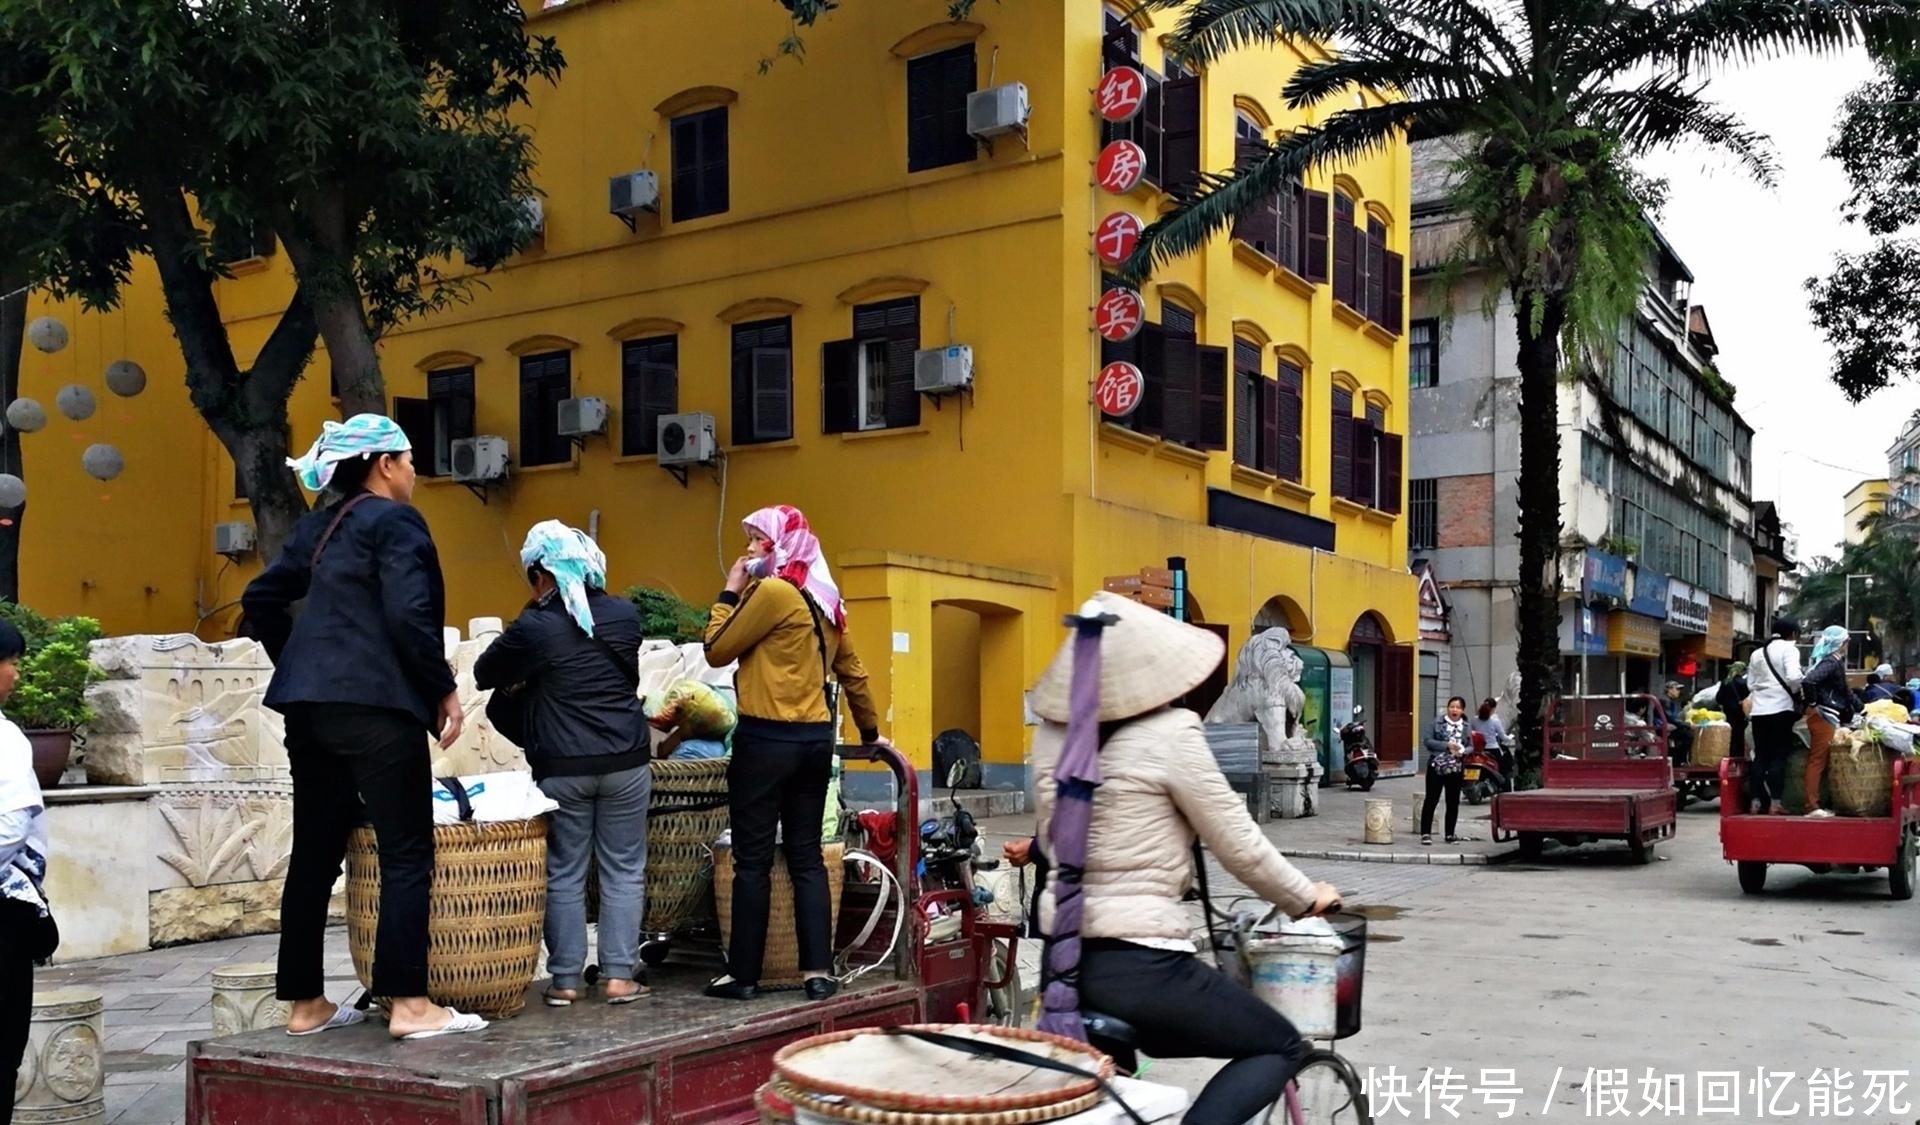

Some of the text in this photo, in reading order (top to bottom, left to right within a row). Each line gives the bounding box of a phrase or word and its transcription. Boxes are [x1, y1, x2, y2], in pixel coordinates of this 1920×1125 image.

[1097, 75, 1139, 409] 红房子宾馆
